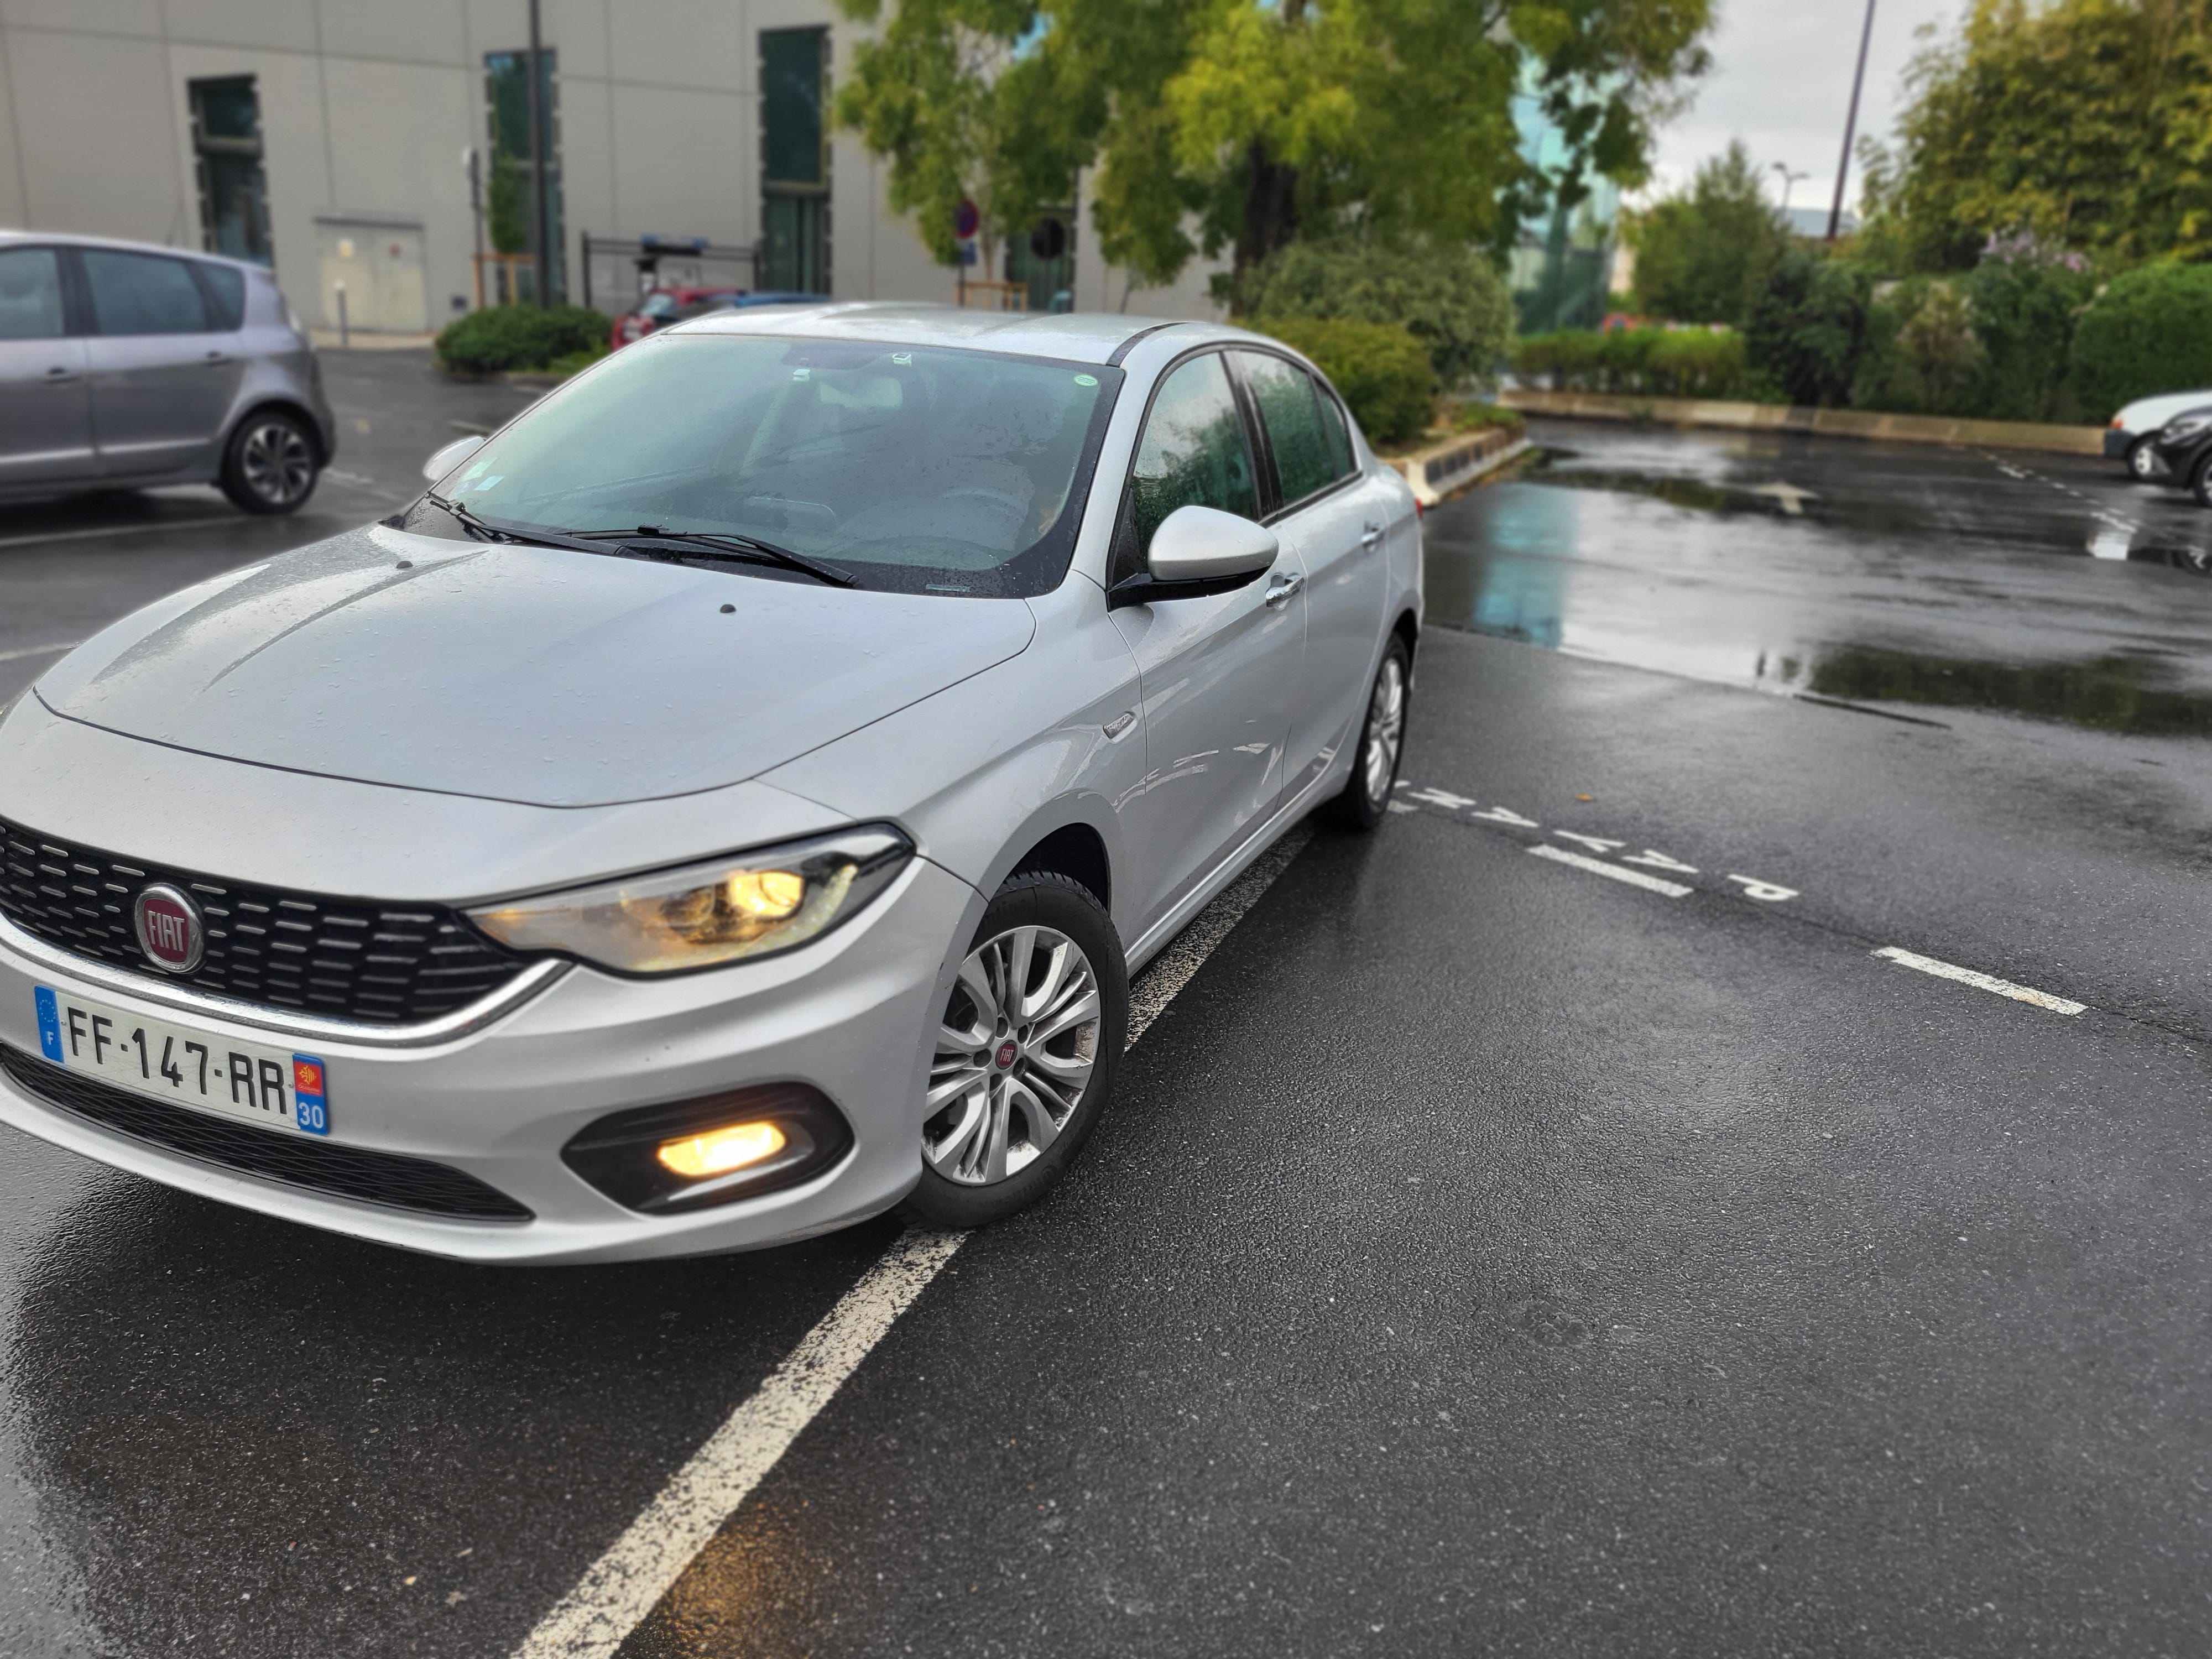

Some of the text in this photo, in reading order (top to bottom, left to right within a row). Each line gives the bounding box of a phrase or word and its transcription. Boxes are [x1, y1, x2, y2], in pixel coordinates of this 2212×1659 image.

[148, 910, 184, 952] FIAT
[48, 1031, 54, 1045] F
[1000, 1048, 1014, 1062] FIAT
[299, 1102, 324, 1129] 30
